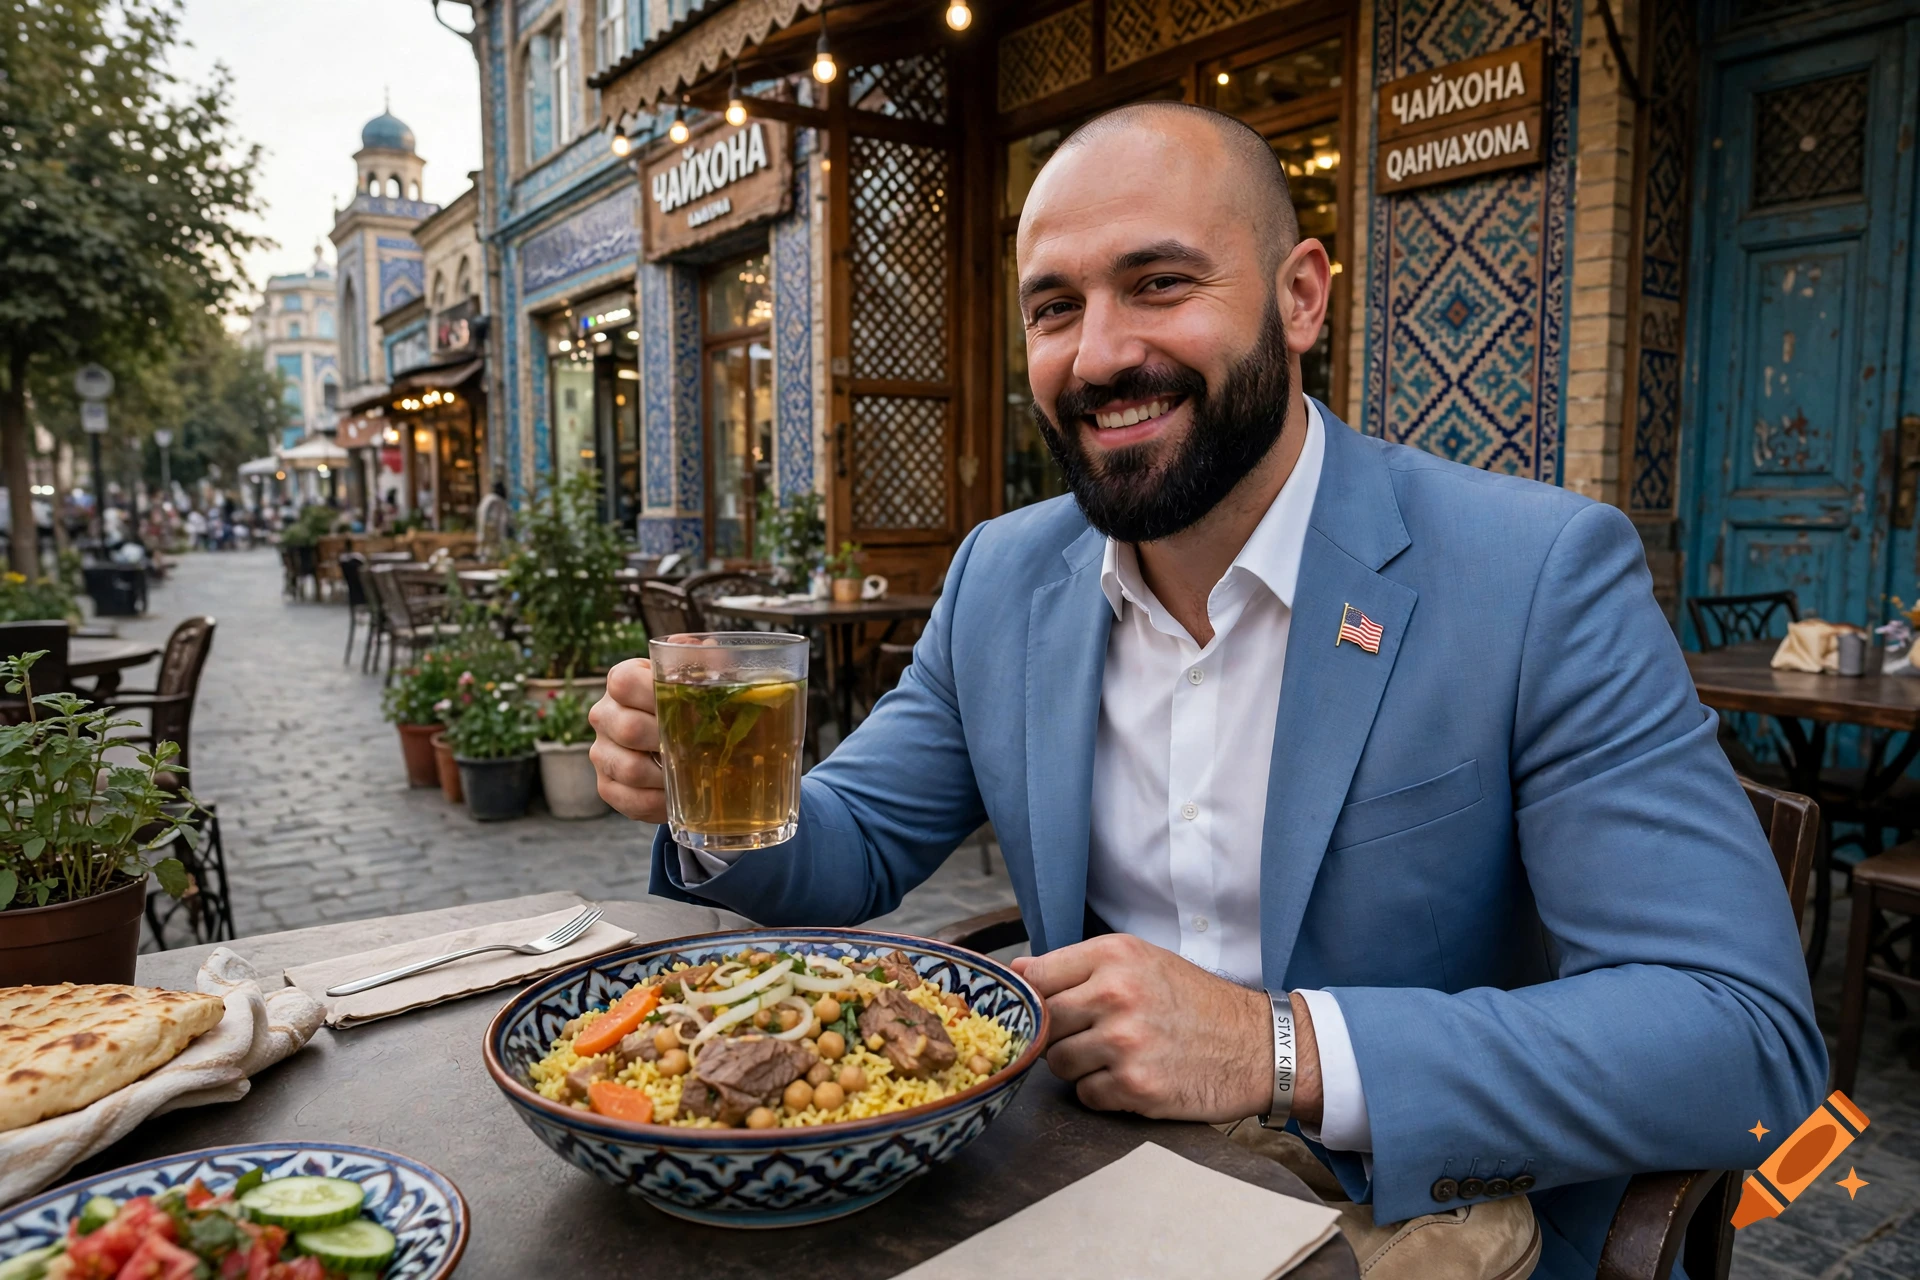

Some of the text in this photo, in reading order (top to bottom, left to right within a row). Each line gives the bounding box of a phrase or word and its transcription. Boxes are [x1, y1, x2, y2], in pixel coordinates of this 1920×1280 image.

[1391, 61, 1525, 125] ЧАЙХОНА
[652, 122, 767, 214] ЧАЙХОНА
[1386, 120, 1529, 182] QAHVAXONA
[1278, 1016, 1292, 1092] STAY KIND
